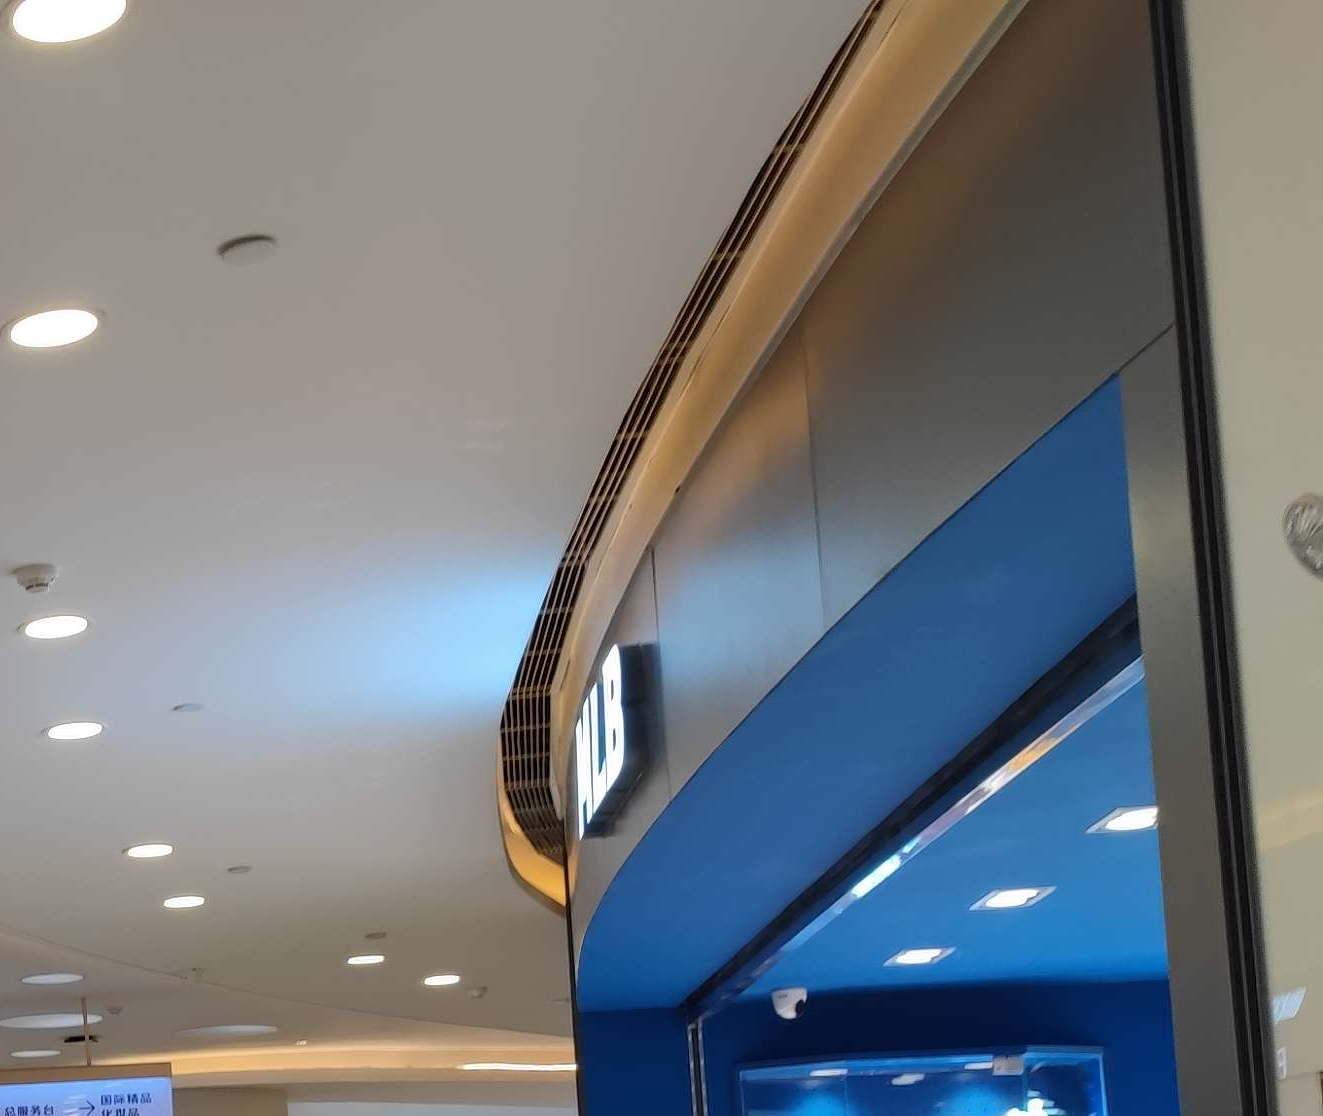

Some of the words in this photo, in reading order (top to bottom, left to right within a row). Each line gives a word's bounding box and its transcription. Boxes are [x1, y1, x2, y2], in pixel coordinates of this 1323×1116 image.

[575, 644, 625, 840] MLB
[5, 1104, 54, 1116] 总服务台
